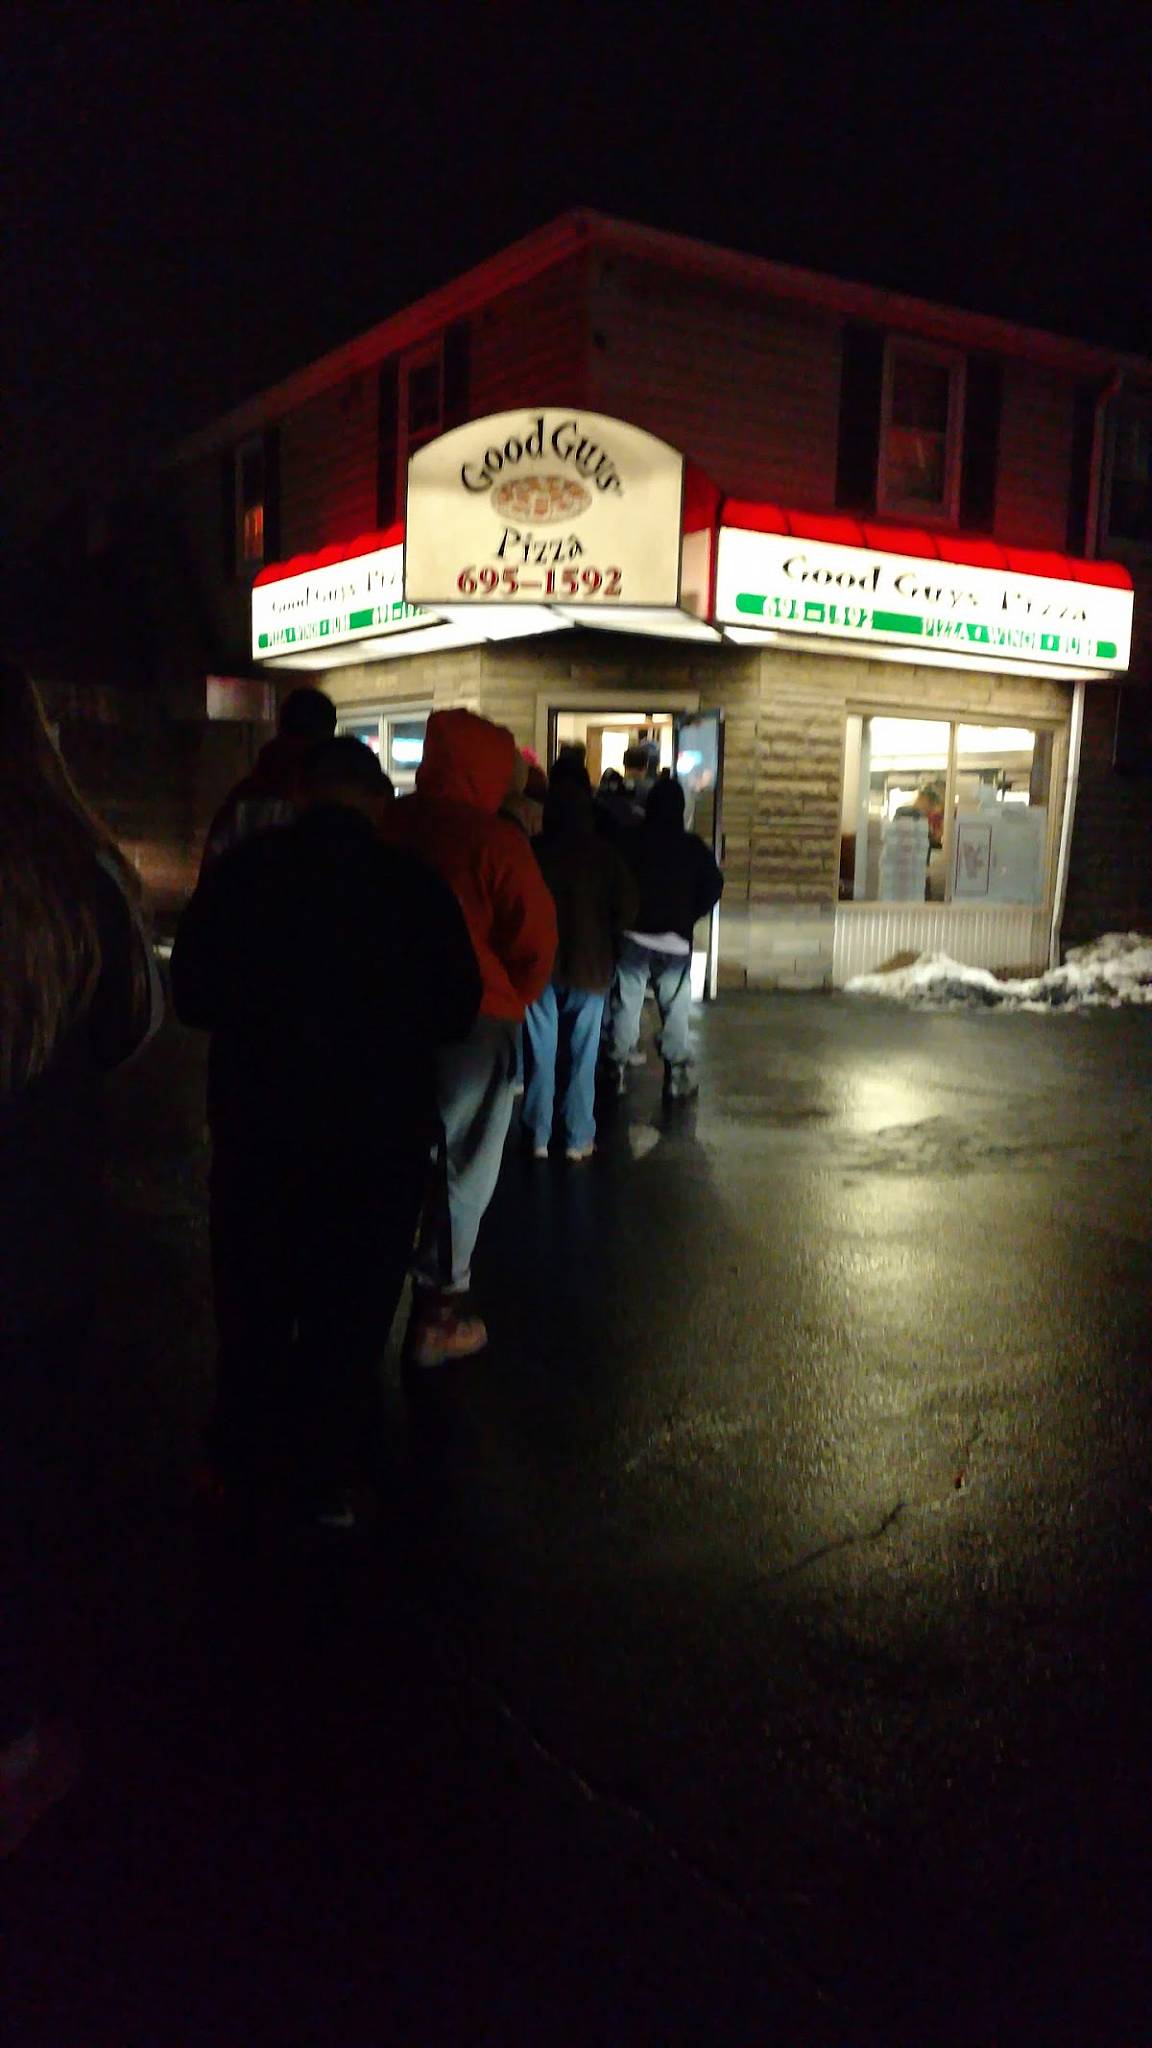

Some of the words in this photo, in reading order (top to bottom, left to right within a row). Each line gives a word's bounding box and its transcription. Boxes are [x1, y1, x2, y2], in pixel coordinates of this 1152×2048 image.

[461, 414, 545, 493] Good
[551, 420, 623, 498] Guys
[497, 526, 583, 563] Pizza
[457, 566, 623, 597] 695-1592
[782, 554, 881, 592] Good
[893, 572, 979, 609] Guys
